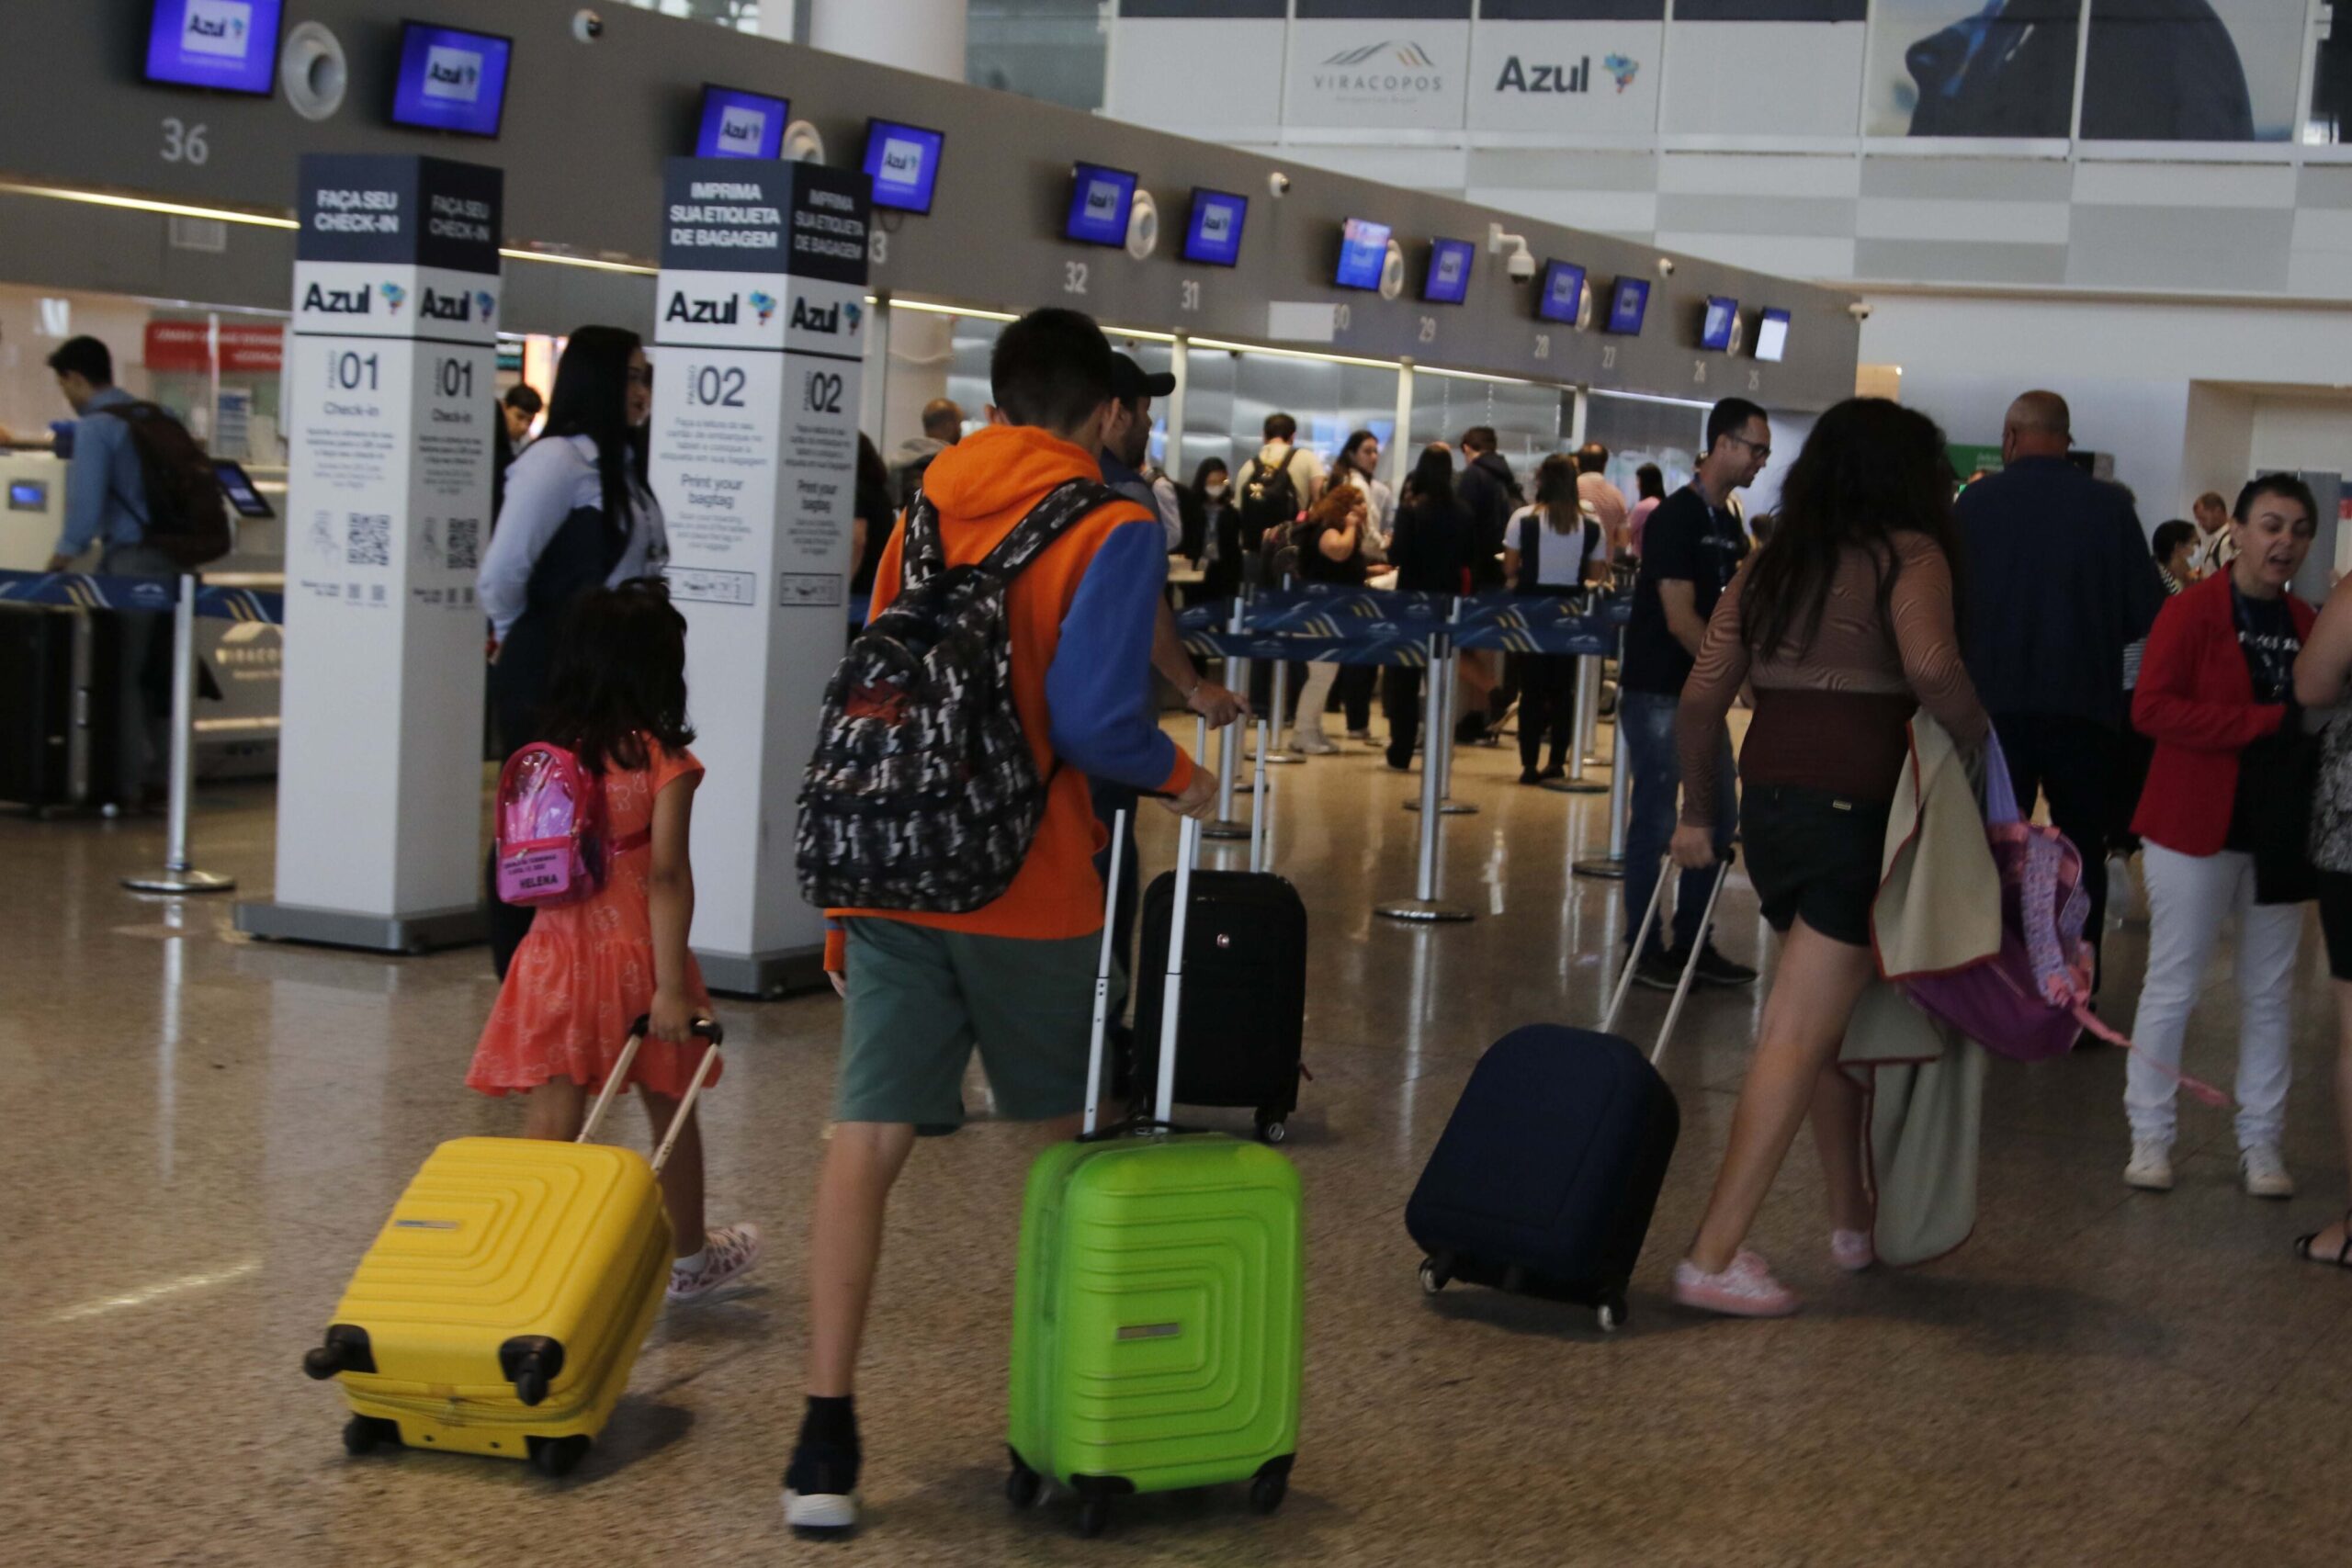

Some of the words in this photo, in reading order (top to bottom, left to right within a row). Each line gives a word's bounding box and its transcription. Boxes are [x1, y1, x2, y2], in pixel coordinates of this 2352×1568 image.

[187, 14, 227, 38] Azul
[429, 61, 462, 85] Azul
[1313, 74, 1442, 91] VIRACOPOS
[1496, 55, 1590, 93] Azul
[160, 117, 209, 164] 36
[722, 122, 749, 140] Azul
[885, 152, 908, 171] Azul
[317, 189, 362, 212] FAÇA
[363, 191, 399, 210] SEU
[691, 182, 763, 201] IMPRIMA
[314, 212, 400, 232] CHECK-IN
[670, 205, 702, 222] SUA
[703, 206, 781, 225] ETIQUETA
[671, 229, 694, 246] DE
[696, 230, 778, 249] BAGAGEM
[795, 234, 809, 251] DE
[1064, 261, 1089, 295] 32
[302, 282, 371, 313] Azul
[419, 287, 470, 321] Azul
[1181, 279, 1200, 310] 31
[665, 291, 738, 325] Azul
[790, 297, 840, 334] Azul
[1419, 316, 1436, 344] 29
[339, 351, 379, 391] 01
[443, 357, 473, 398] 01
[698, 365, 746, 408] 02
[811, 371, 843, 414] 02
[681, 473, 711, 489] Print
[714, 479, 744, 491] your
[688, 493, 735, 510] bagtag
[519, 874, 559, 890] HELENA
